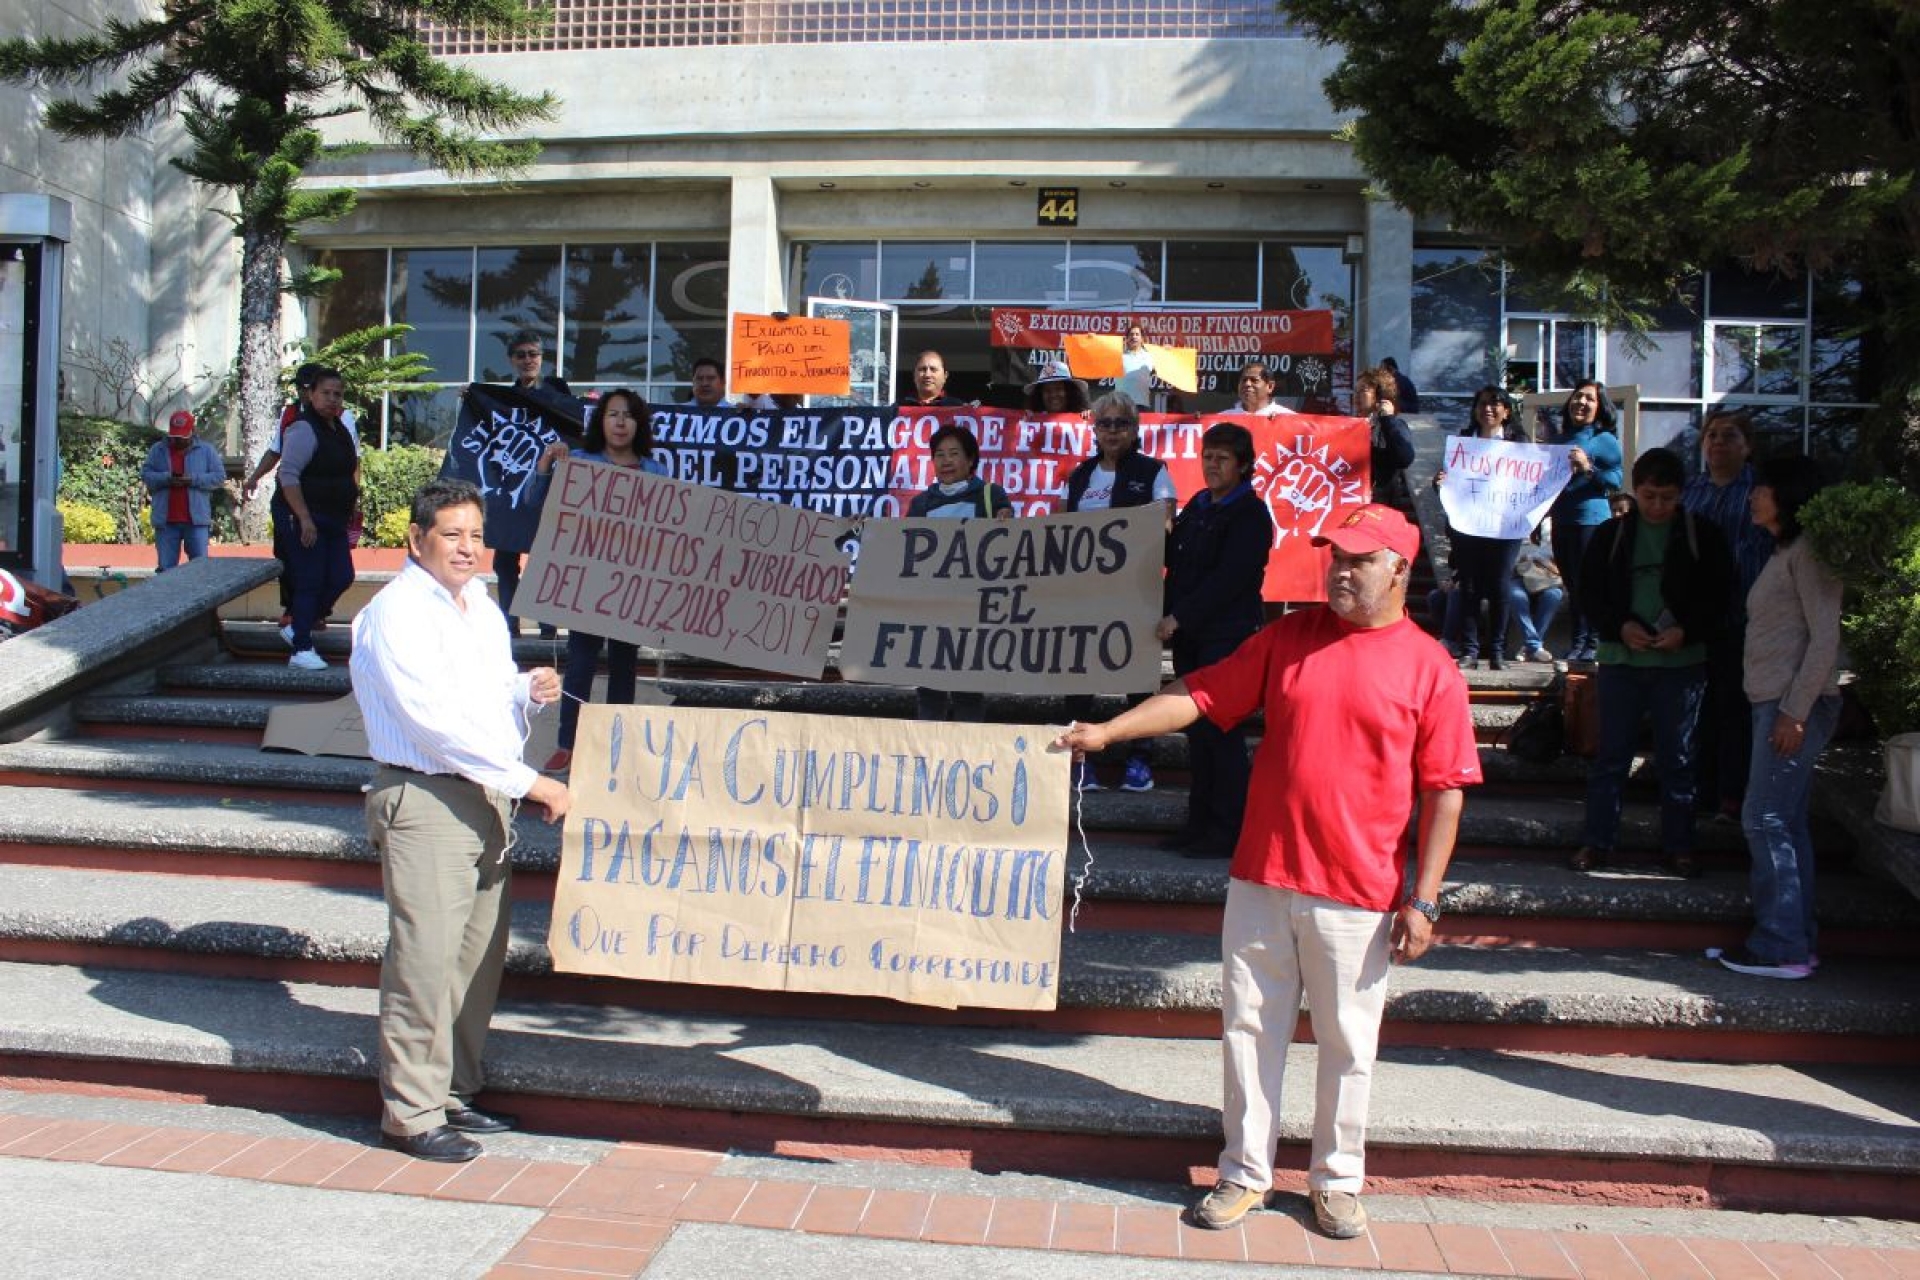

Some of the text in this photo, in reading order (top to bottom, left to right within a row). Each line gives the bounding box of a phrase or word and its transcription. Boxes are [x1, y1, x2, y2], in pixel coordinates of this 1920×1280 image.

[1040, 199, 1076, 221] 44
[752, 341, 825, 356] PAGO DEL
[813, 326, 832, 336] EL
[1029, 314, 1111, 331] EXIGIMOS
[1140, 316, 1177, 333] PAGO
[1181, 316, 1202, 333] DE
[1206, 315, 1292, 334] FINIQUITO
[461, 407, 561, 454] STAUAE
[779, 415, 828, 450] EL
[839, 415, 940, 450] PAGO
[651, 447, 723, 488] DEL
[734, 452, 938, 491] PERSONAL
[1251, 434, 1363, 505] STAUAEM
[559, 461, 692, 527] EXIGIMOS
[704, 494, 780, 548] PAGO
[791, 512, 835, 558] DE
[551, 510, 705, 577] FINIQUITOS
[705, 543, 725, 583] A
[730, 548, 849, 605] JUBILADOS
[899, 517, 1129, 582] PÁGANOS
[535, 562, 588, 614] DEL
[742, 600, 820, 657] 2019
[977, 584, 1036, 625] EL
[870, 620, 1133, 675] FINIQUITO
[637, 719, 705, 801] YA
[723, 717, 998, 823] CUMPLIMOS
[576, 816, 1064, 920] PAGANOS EL FINIQUITO
[647, 914, 705, 956] POR
[721, 923, 847, 968] DERECHO
[868, 936, 1056, 988] CORRESPONDE
